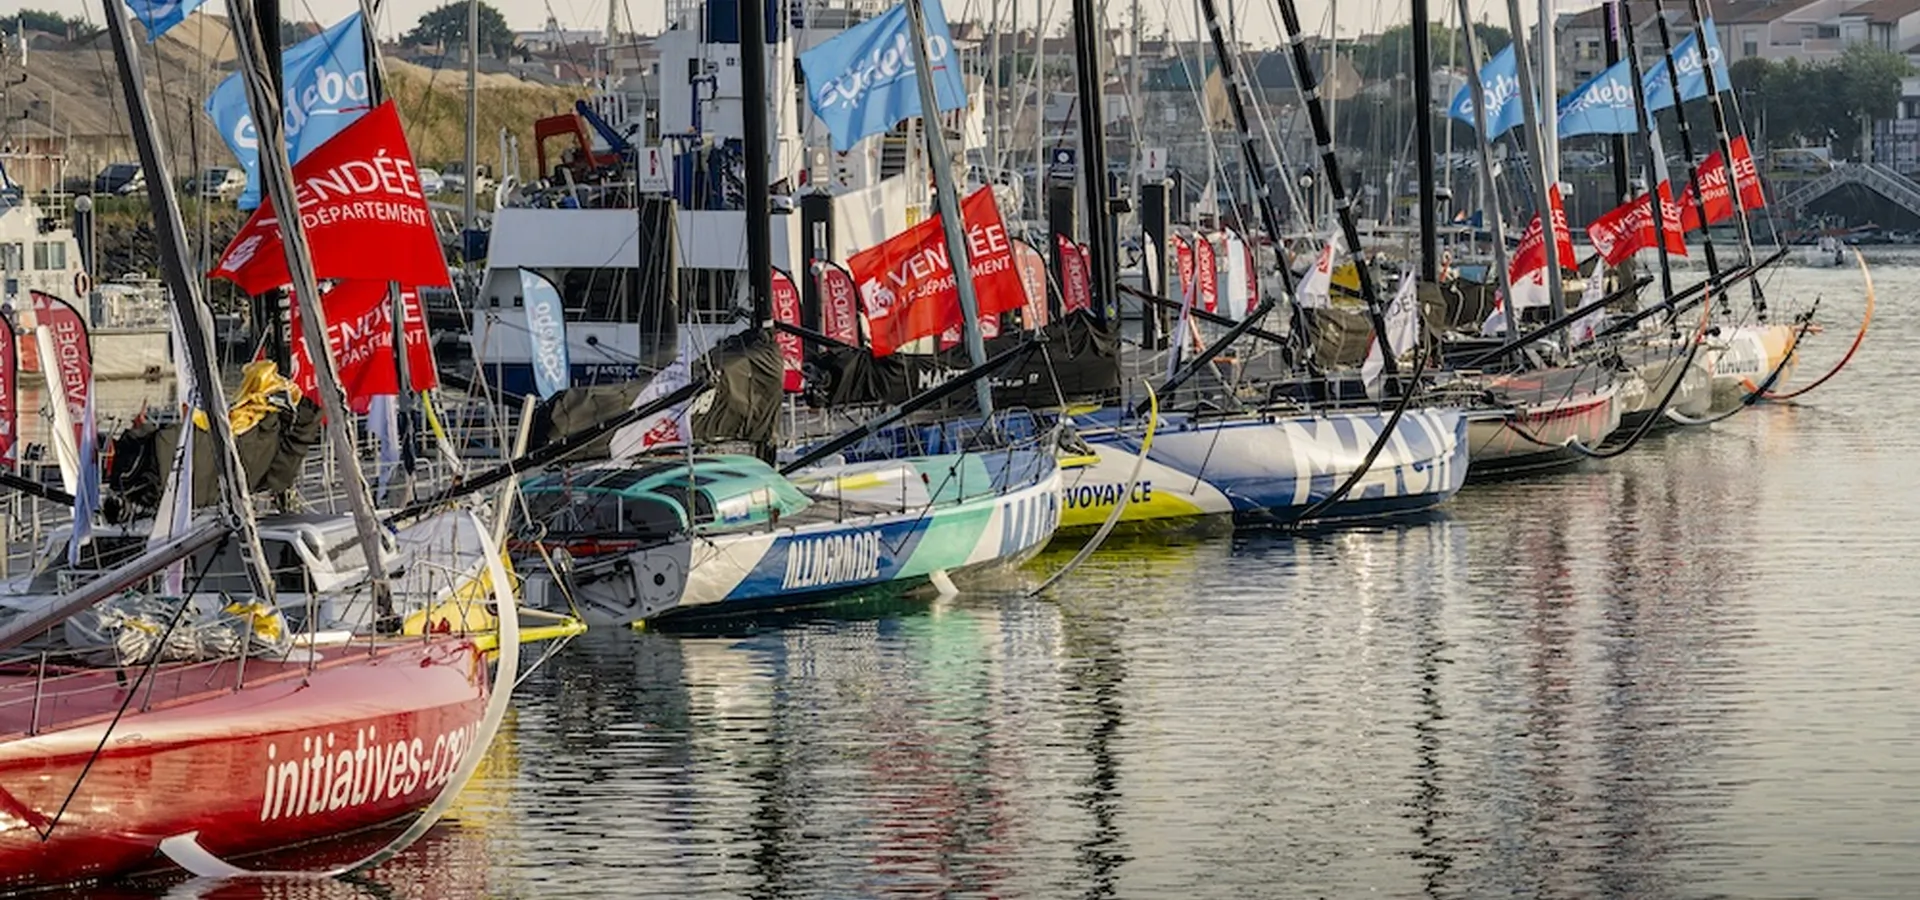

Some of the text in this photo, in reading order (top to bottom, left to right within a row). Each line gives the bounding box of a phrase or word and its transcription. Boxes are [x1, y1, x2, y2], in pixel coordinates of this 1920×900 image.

[1698, 158, 1755, 190] ENDÉE
[303, 201, 427, 229] DÉPARTEMENT
[1609, 197, 1679, 234] VENÉE
[888, 224, 1008, 288] VENÉE
[916, 255, 1011, 299] DÉPARMENT
[1062, 481, 1152, 510] VOYANCE
